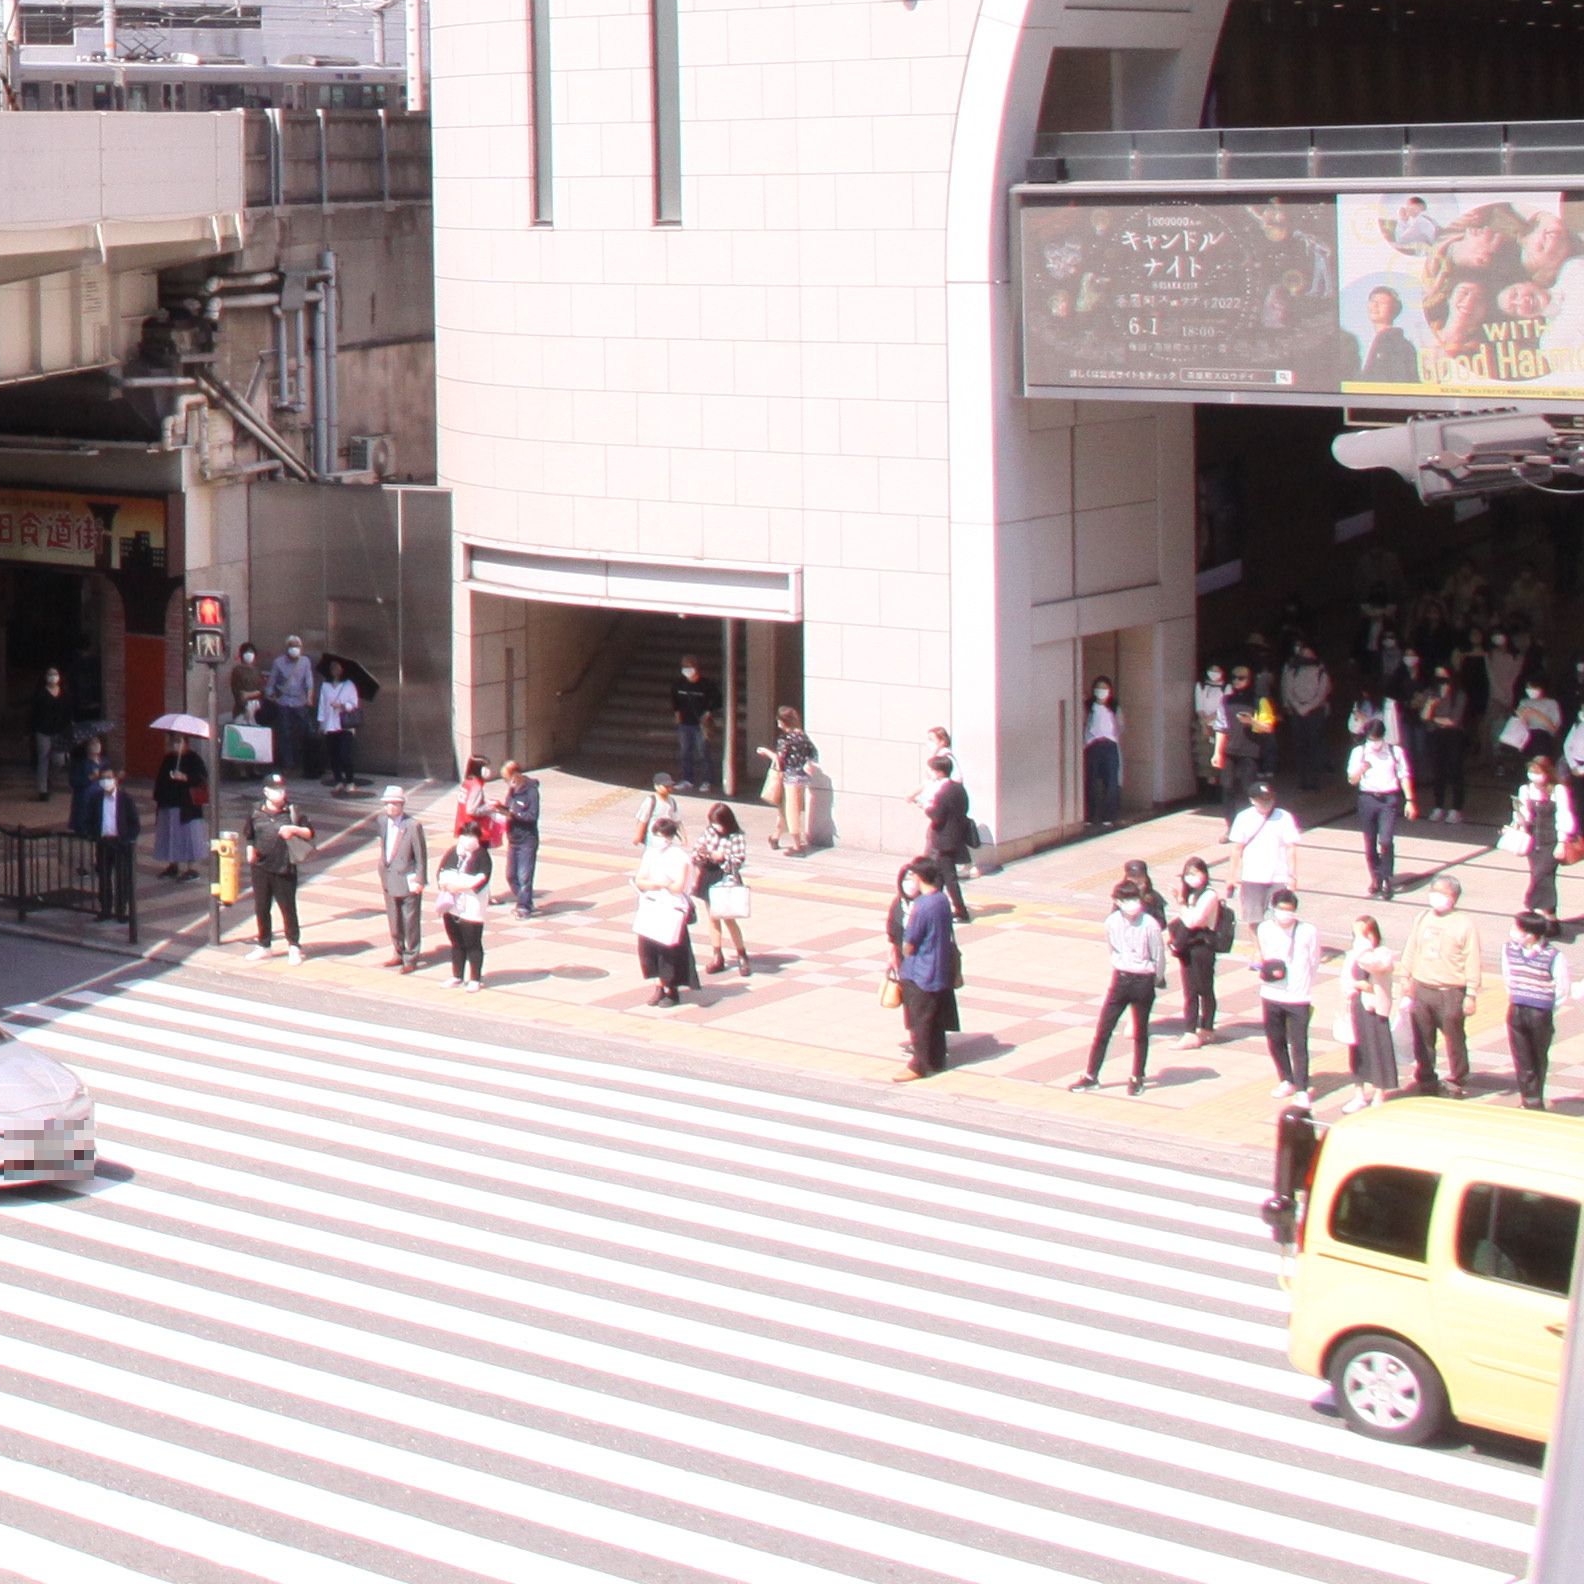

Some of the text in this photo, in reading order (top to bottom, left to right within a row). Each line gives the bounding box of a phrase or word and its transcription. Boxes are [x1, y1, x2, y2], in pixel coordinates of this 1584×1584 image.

[1121, 229, 1225, 252] キャンドル
[1143, 255, 1202, 278] ナイト
[1128, 317, 1159, 335] 6.1
[1483, 319, 1551, 342] WITH
